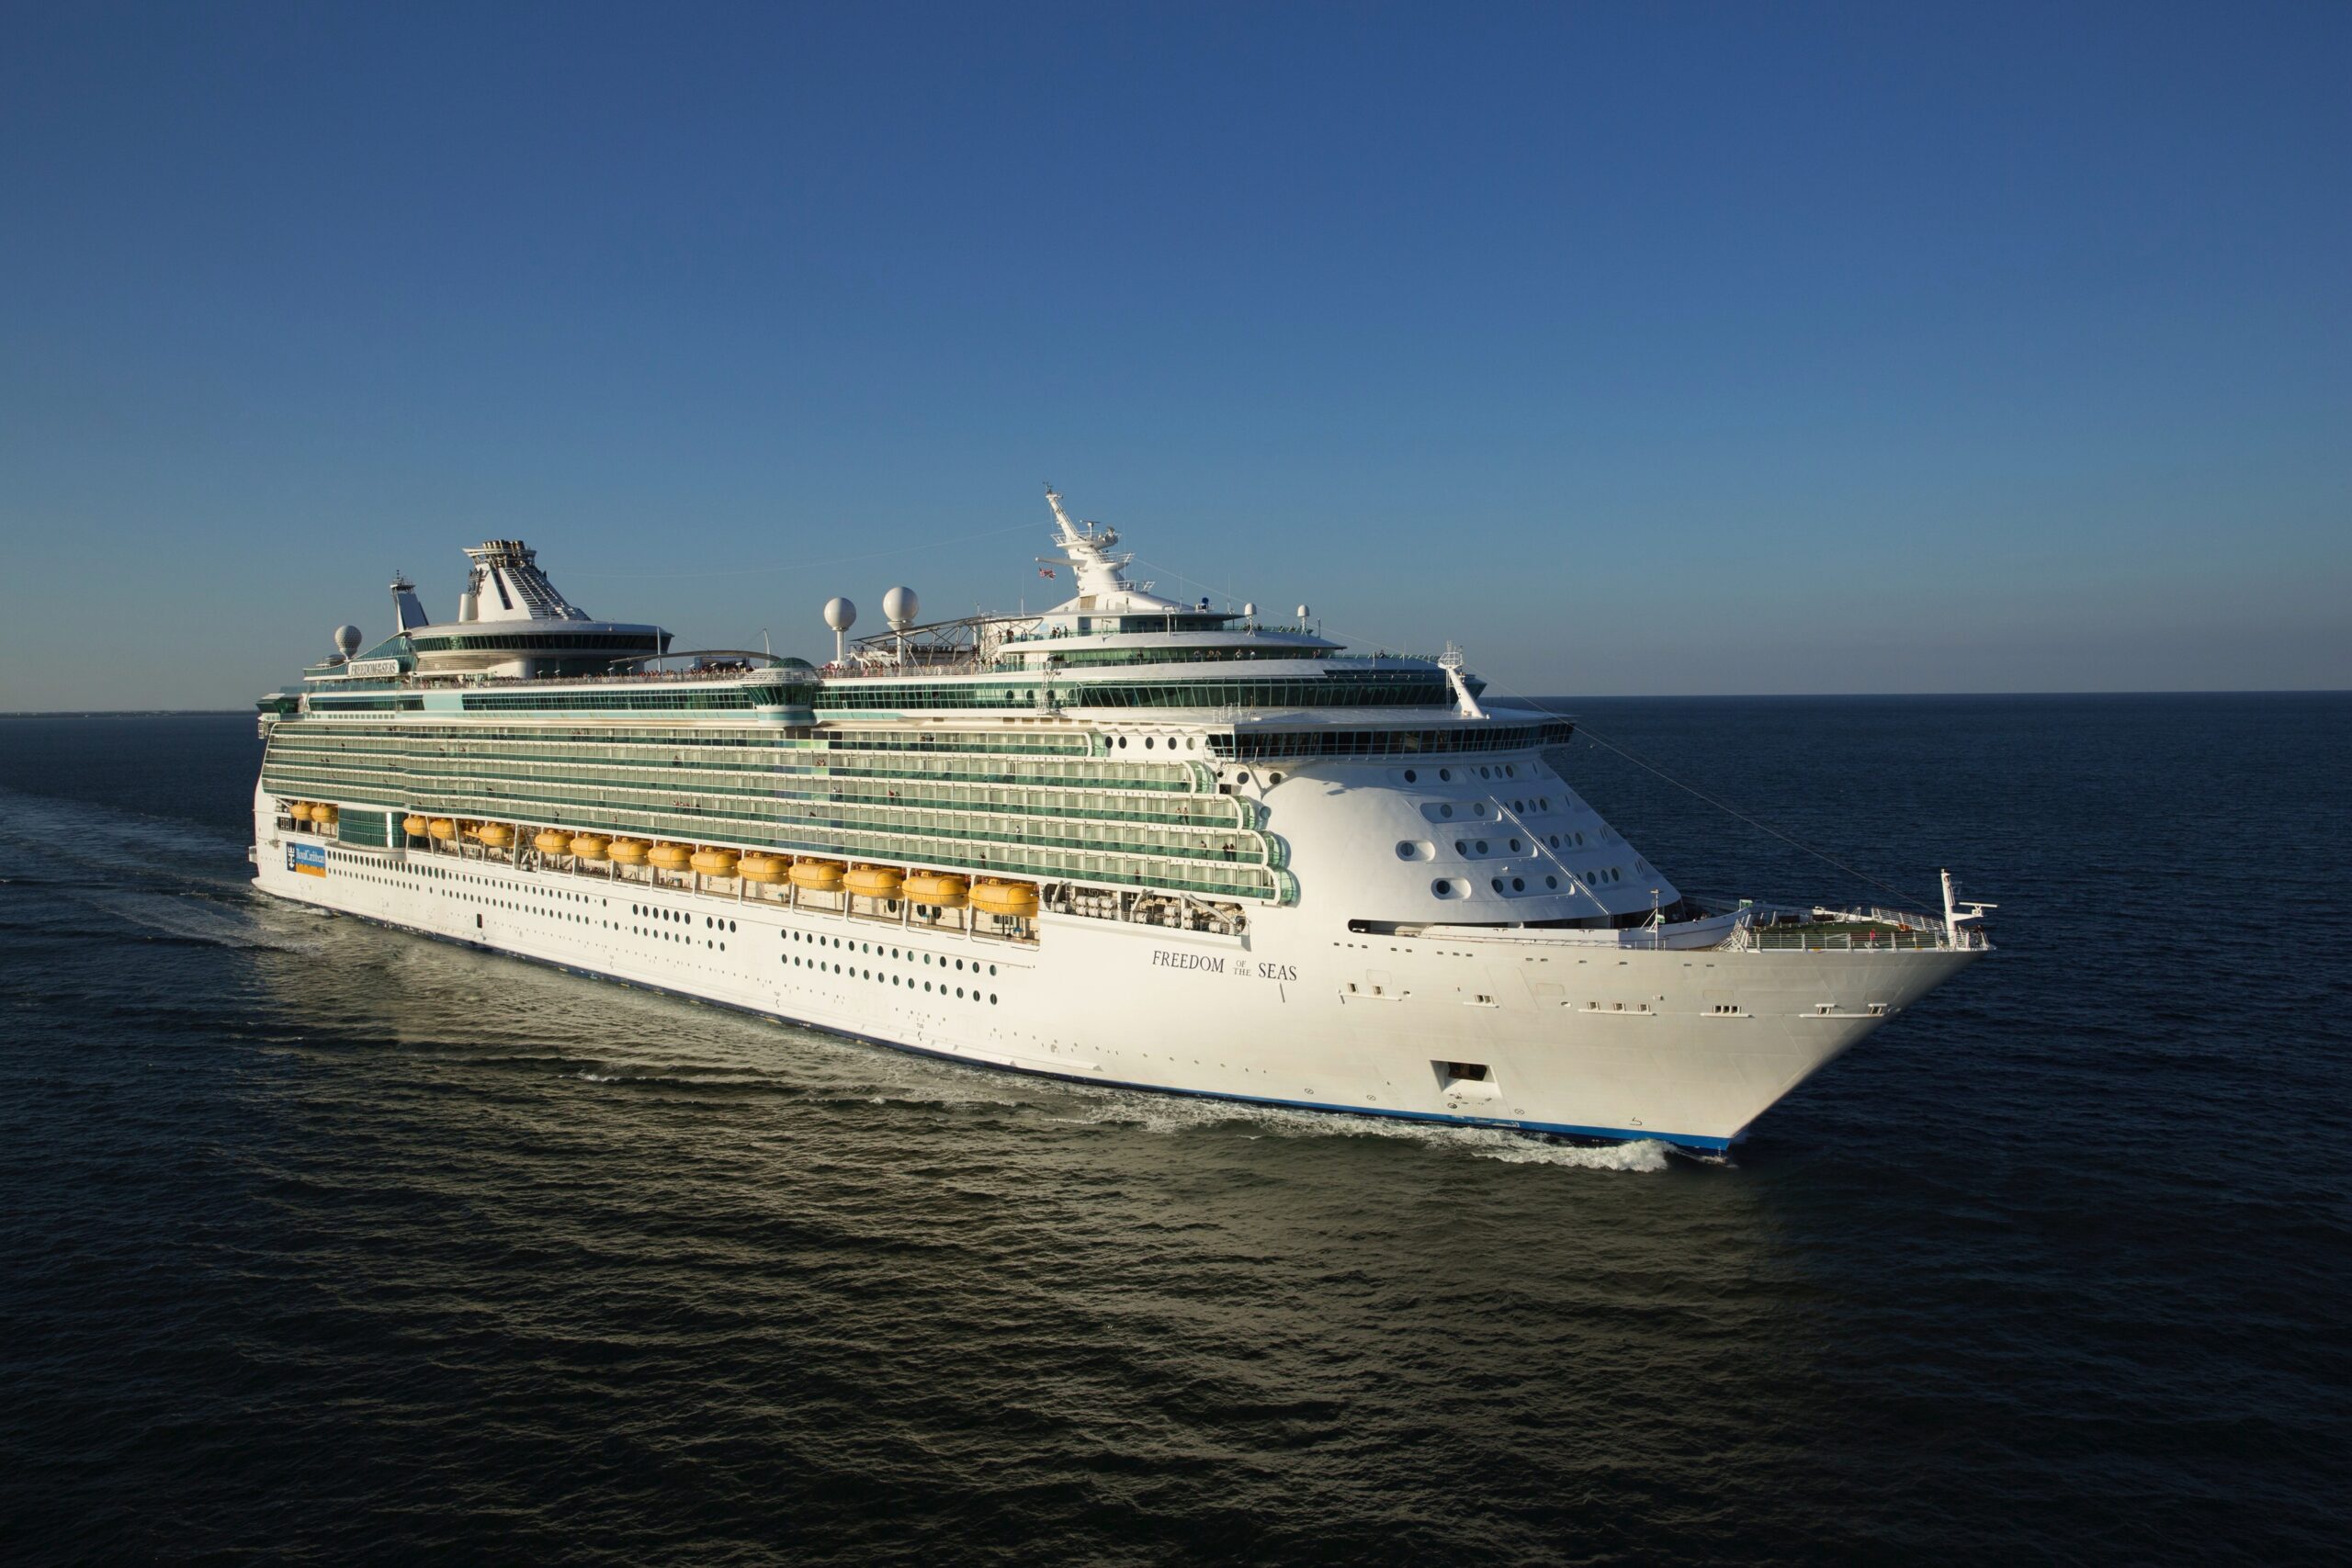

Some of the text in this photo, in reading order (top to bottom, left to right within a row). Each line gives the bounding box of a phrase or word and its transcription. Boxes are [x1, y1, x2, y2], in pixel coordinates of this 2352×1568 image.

[1152, 950, 1225, 974] FREEDOM
[1232, 967, 1251, 976] THE
[1258, 962, 1297, 981] SEAS
